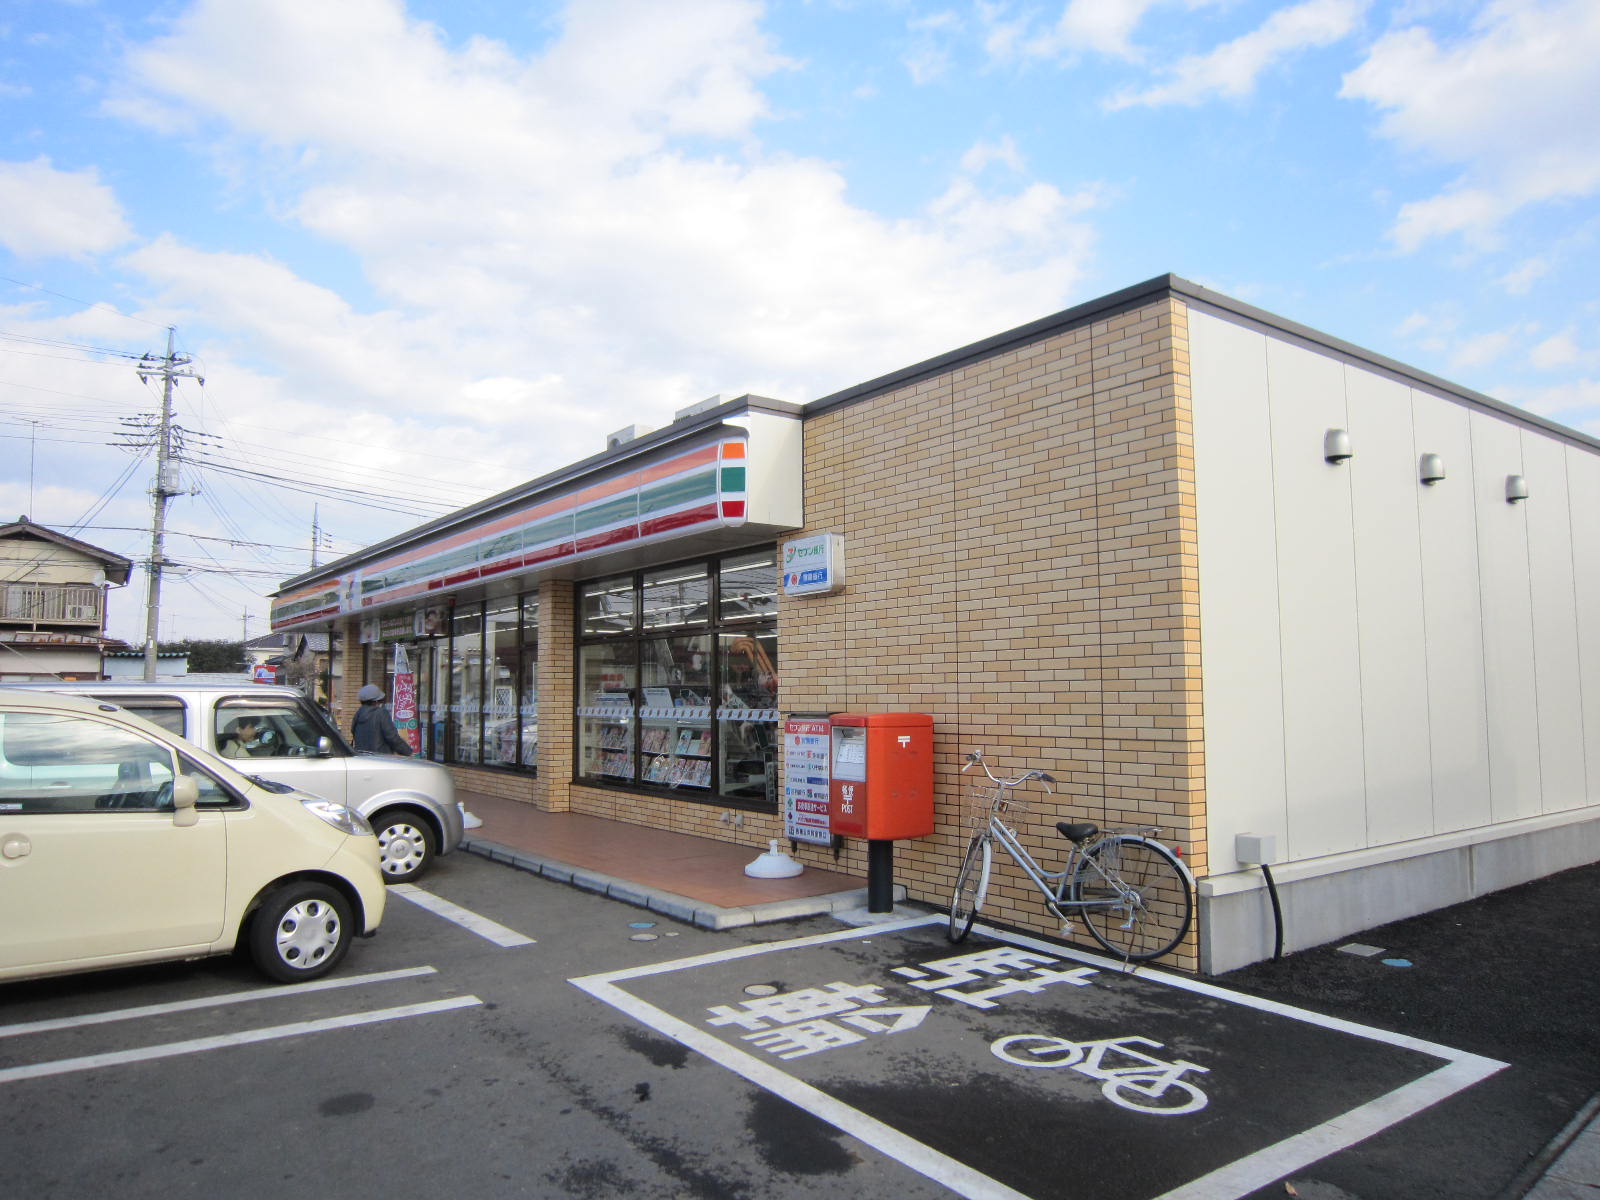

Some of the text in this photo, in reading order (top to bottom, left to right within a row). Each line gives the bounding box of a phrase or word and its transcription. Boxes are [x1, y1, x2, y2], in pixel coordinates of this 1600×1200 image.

[798, 545, 824, 557] セブン銀行
[841, 785, 854, 796] 郵便
[841, 803, 854, 814] POST
[706, 945, 1100, 1061] 駐輪
